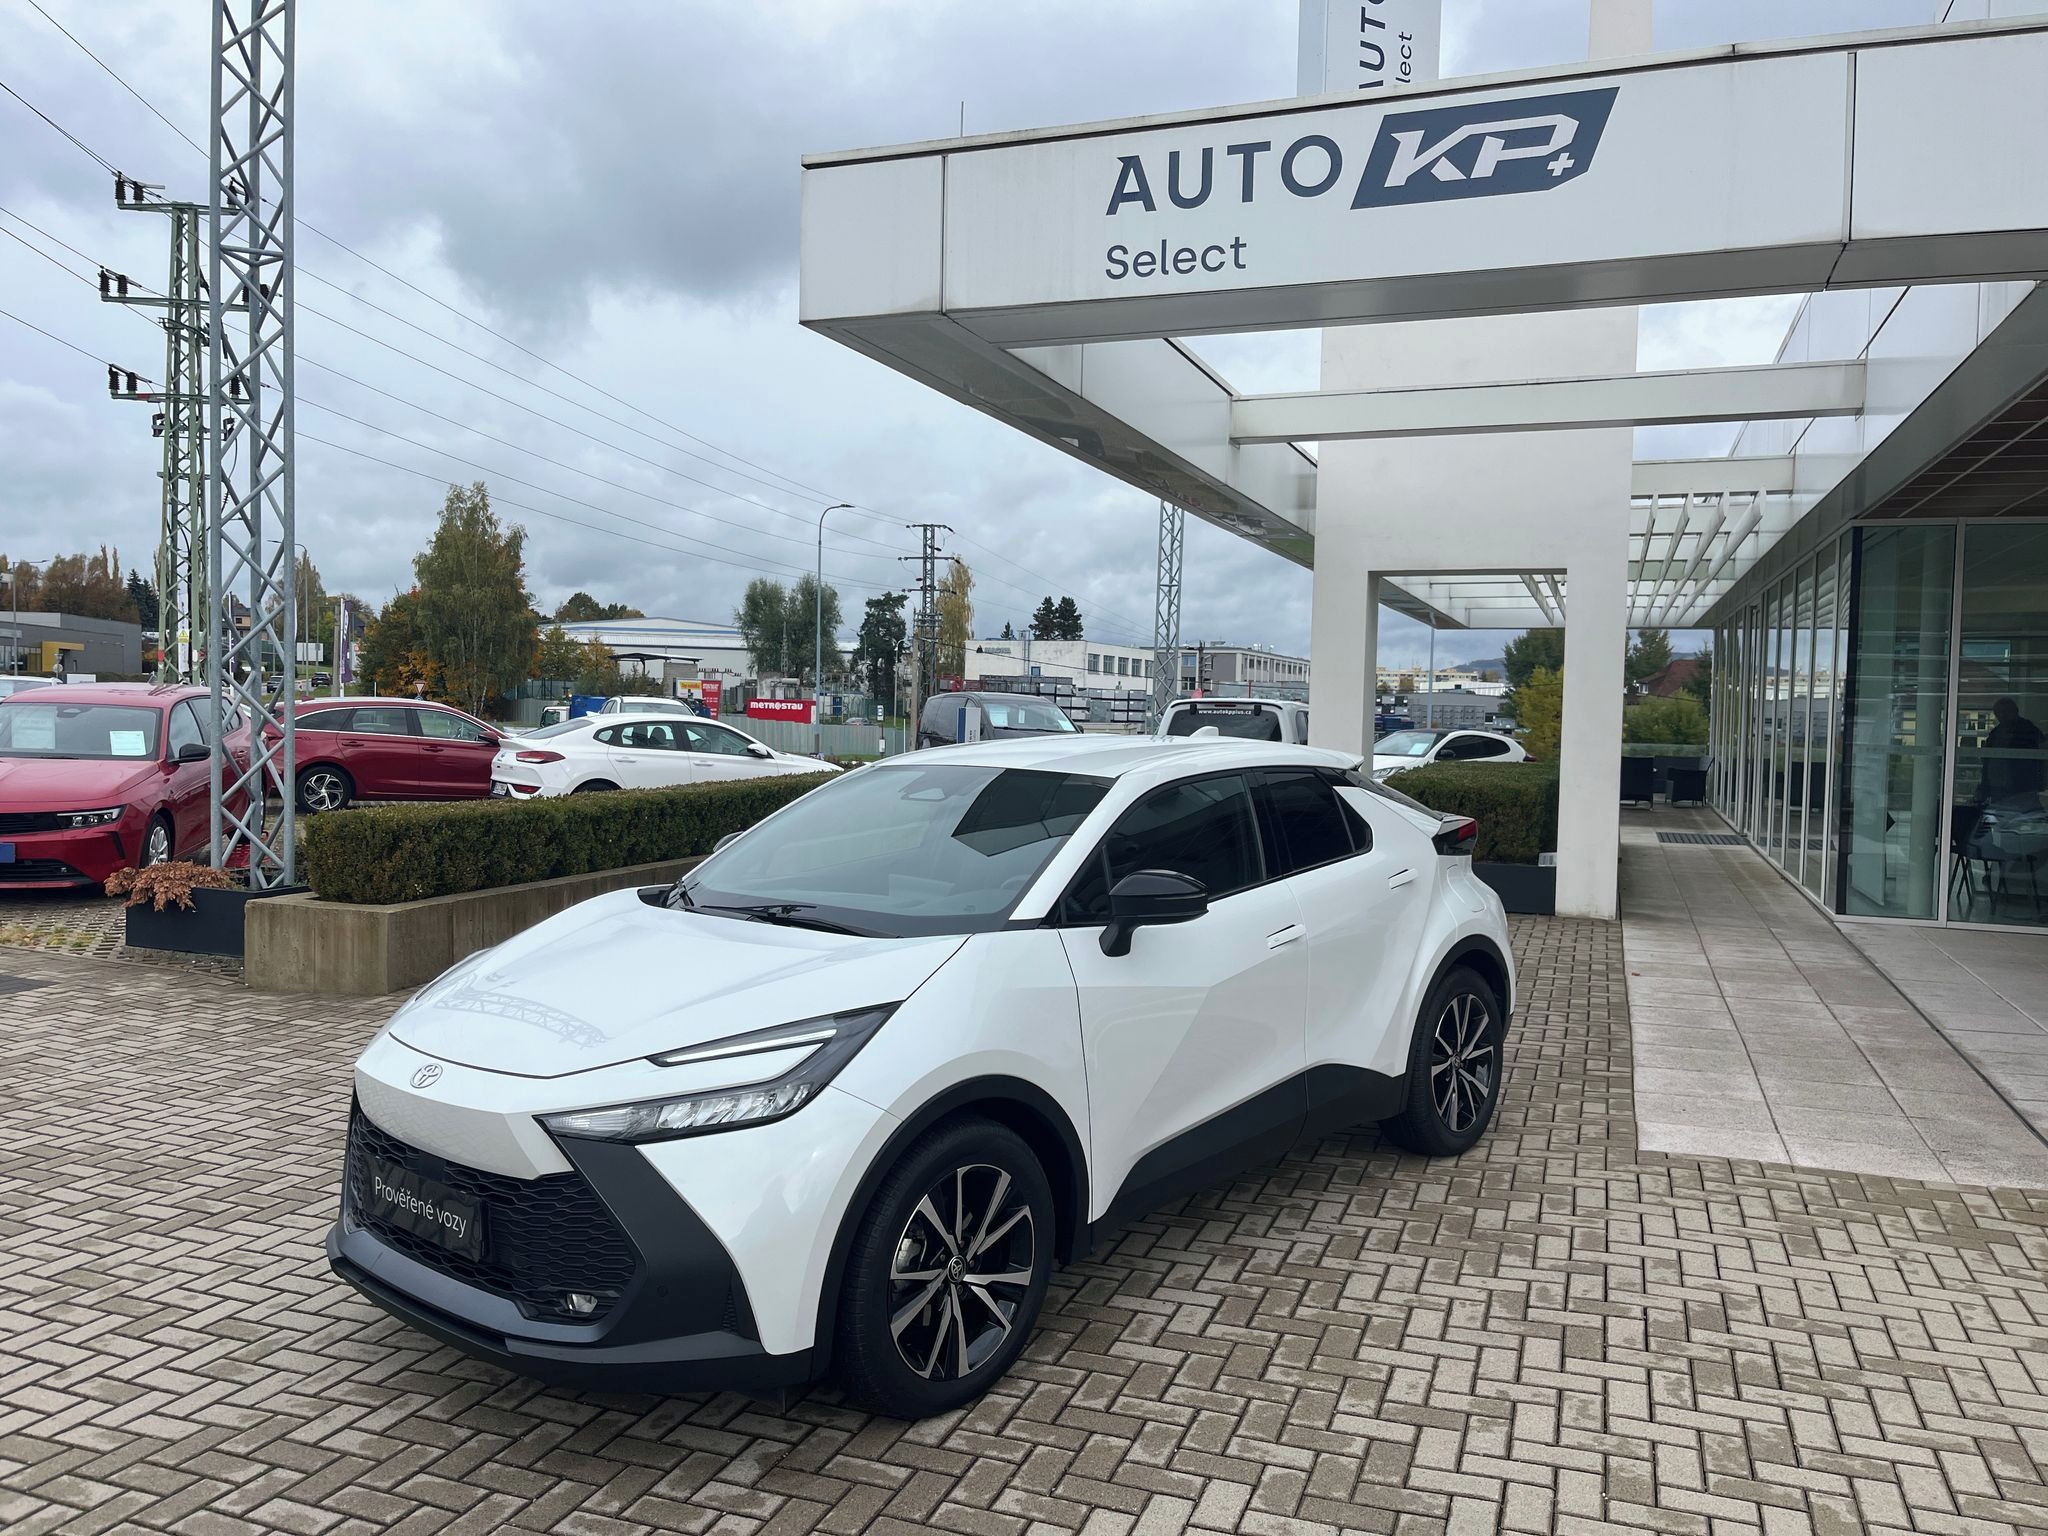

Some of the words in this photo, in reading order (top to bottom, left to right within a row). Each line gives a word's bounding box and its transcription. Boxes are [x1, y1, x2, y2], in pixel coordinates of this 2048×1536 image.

[1105, 134, 1343, 216] AUTO
[1105, 236, 1248, 280] Select
[375, 1175, 434, 1220] Prověřené
[436, 1207, 467, 1238] vozy
